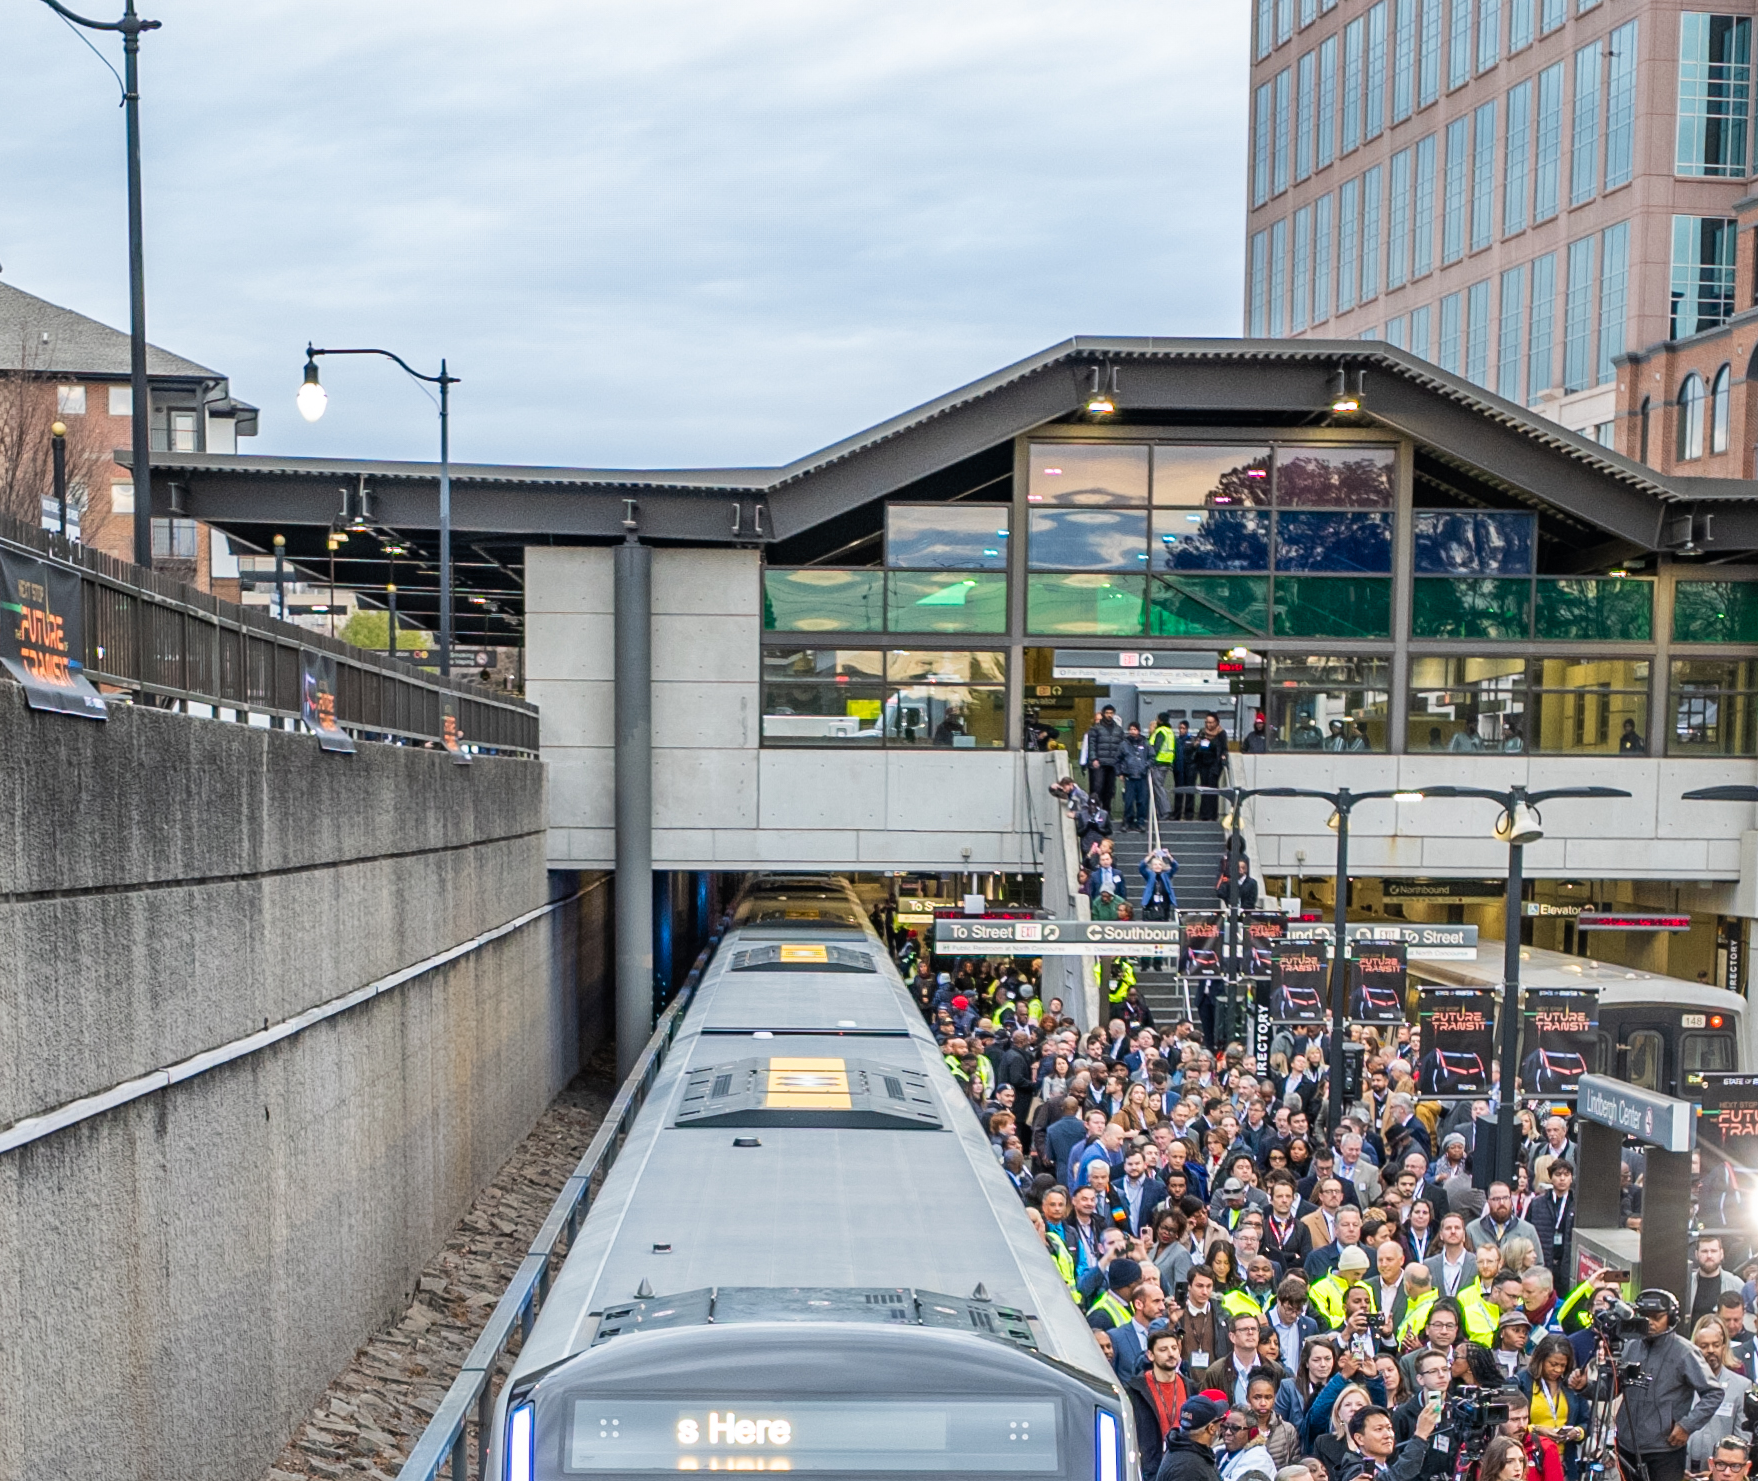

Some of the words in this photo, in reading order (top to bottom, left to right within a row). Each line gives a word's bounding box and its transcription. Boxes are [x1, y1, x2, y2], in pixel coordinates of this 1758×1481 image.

[21, 605, 65, 651] FUTURE
[1400, 884, 1450, 895] Northbound
[909, 901, 922, 912] To
[951, 925, 968, 938] To
[972, 924, 1013, 938] Street
[1020, 926, 1037, 938] EXIT
[1104, 926, 1179, 941] Southboun
[1403, 930, 1420, 944] To
[1423, 929, 1464, 944] Street
[1431, 1011, 1483, 1021] FUTURE
[1535, 1012, 1586, 1022] FUTURE
[1686, 1017, 1703, 1026] 148
[1432, 1021, 1487, 1031] TRANSIT
[1536, 1022, 1591, 1032] TRANSIT
[1257, 1004, 1269, 1077] IRECTORY
[1586, 1087, 1618, 1127] Lindbergh
[1618, 1099, 1642, 1130] Center
[677, 1418, 700, 1444] s
[708, 1412, 792, 1444] Here
